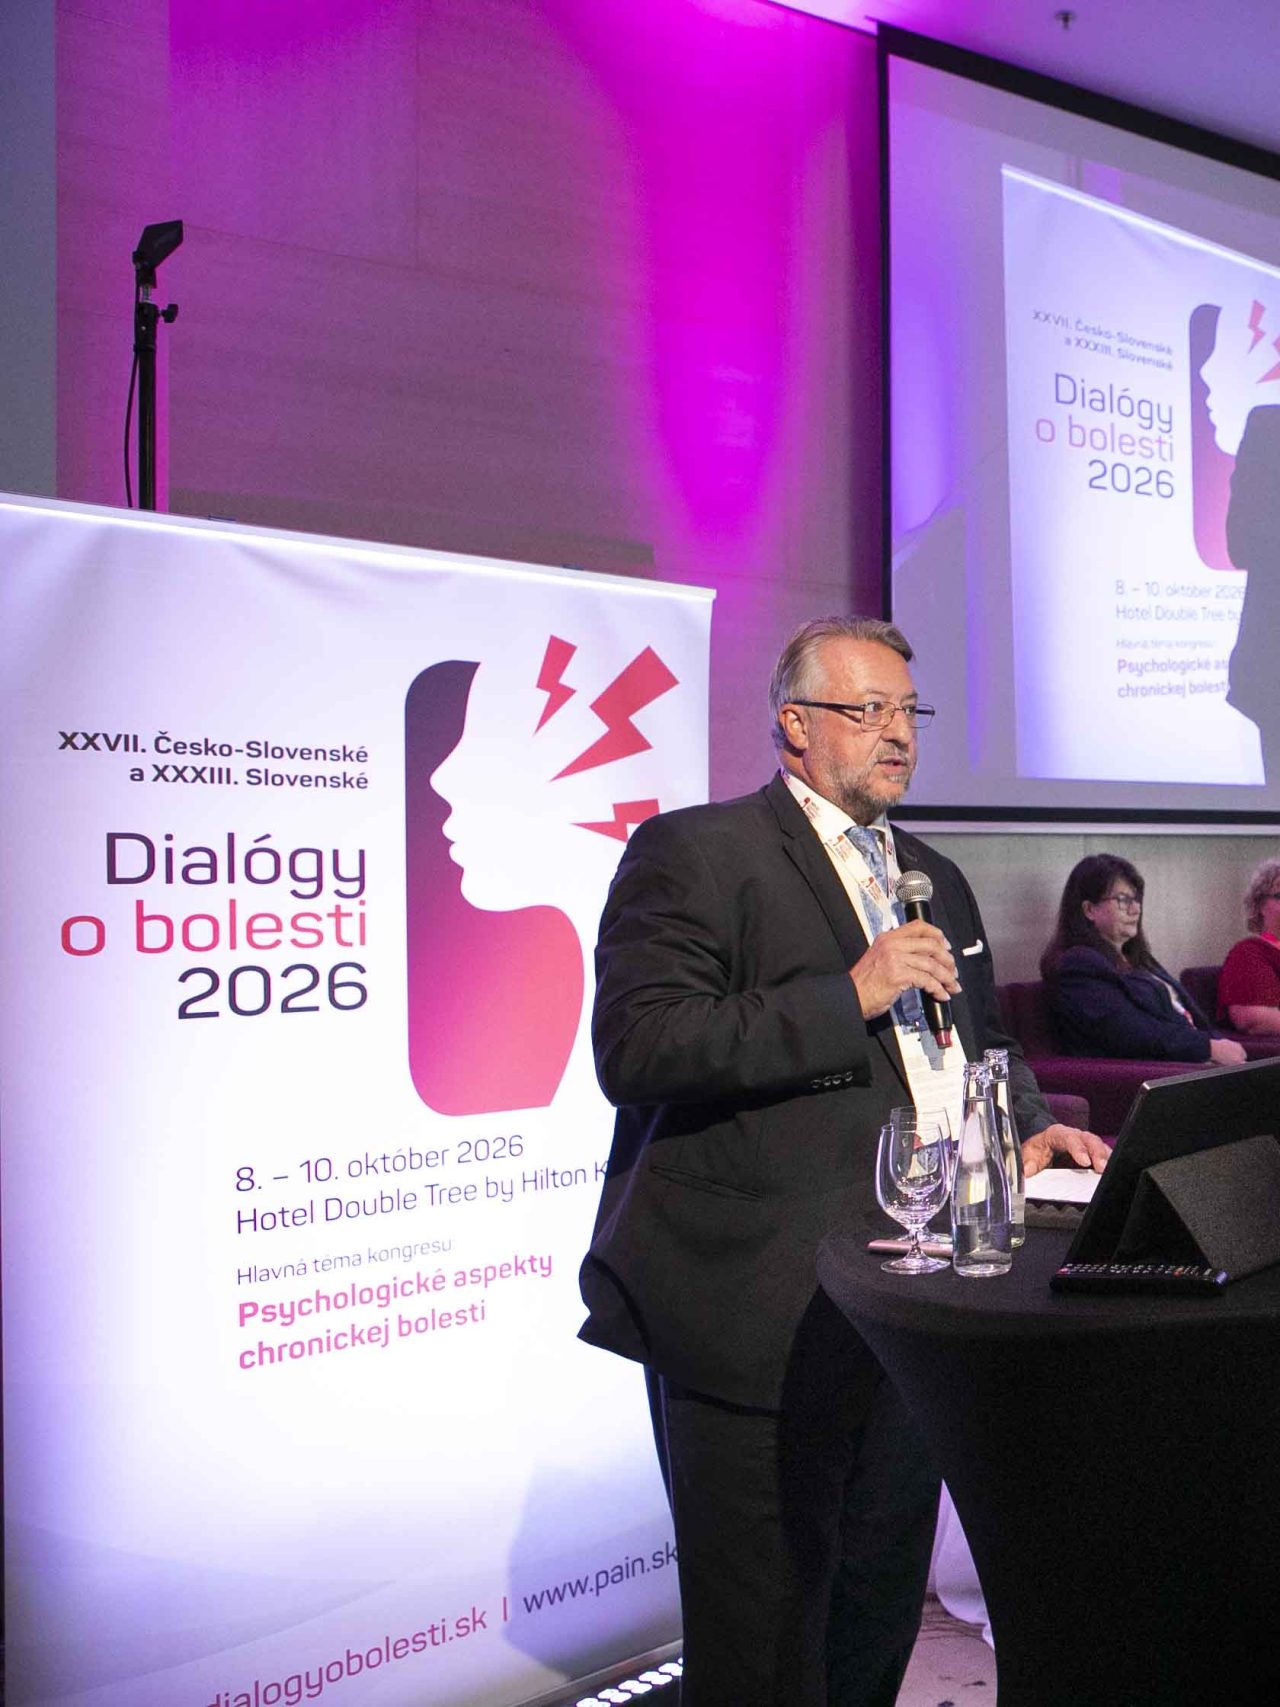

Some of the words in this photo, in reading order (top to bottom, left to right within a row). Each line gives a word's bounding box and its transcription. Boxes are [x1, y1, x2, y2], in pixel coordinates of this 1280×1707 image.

[1055, 372, 1172, 433] Dialógy
[1036, 418, 1056, 442] o
[1069, 414, 1174, 462] bolesti
[1088, 459, 1175, 498] 2026
[58, 731, 147, 754] XXVII.
[154, 730, 369, 763] Česko-Slovenské
[129, 766, 145, 783] a
[151, 764, 239, 786] XXXIII.
[245, 766, 369, 789] Slovenské
[106, 831, 367, 900] Dialógy
[60, 914, 106, 956] o
[136, 898, 367, 954] bolesti
[178, 961, 368, 1020] 2026
[236, 1166, 262, 1192] 8.
[299, 1158, 338, 1184] 10.
[348, 1146, 449, 1178] október
[457, 1134, 524, 1164] 2026
[237, 1201, 315, 1234] Hotel
[325, 1188, 417, 1222] Double
[425, 1183, 477, 1206] Tree
[486, 1176, 513, 1202] by
[522, 1165, 587, 1193] Hilton
[237, 1258, 307, 1285] Hlavná
[314, 1252, 362, 1274] téma
[239, 1268, 446, 1327] Psychologické
[454, 1253, 553, 1288] aspekty
[239, 1318, 390, 1370] chronickej
[398, 1300, 486, 1337] bolesti
[523, 1541, 679, 1613] www.pain.sk
